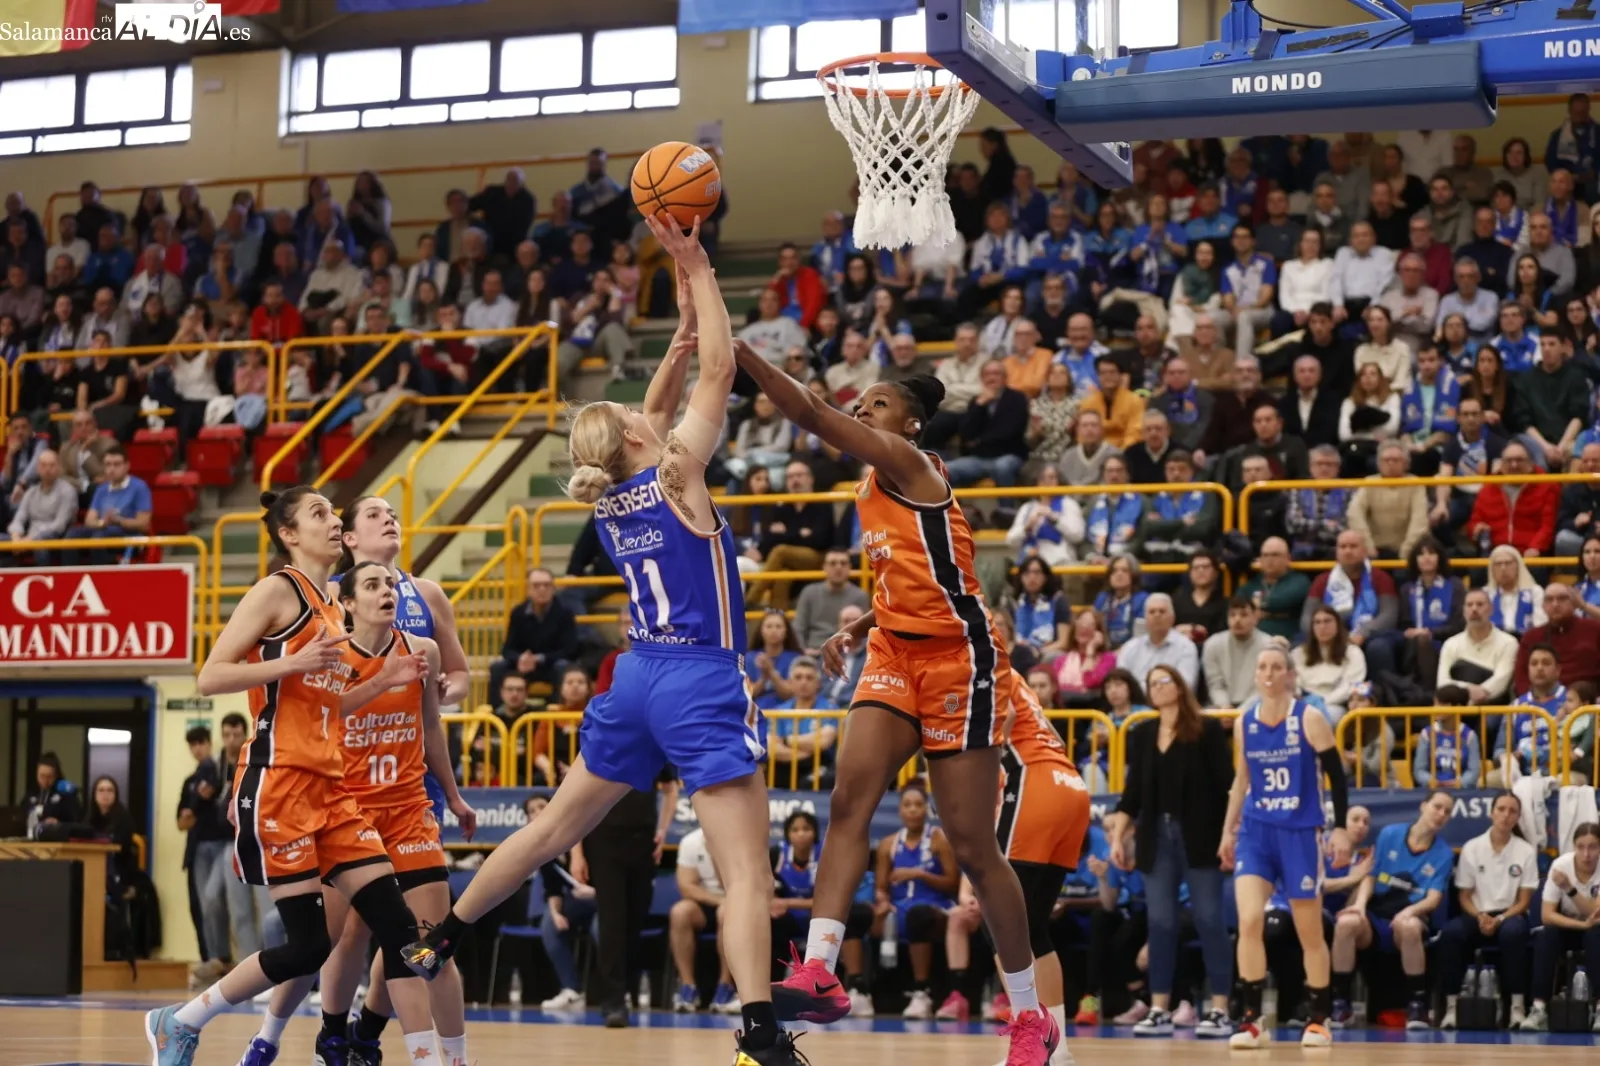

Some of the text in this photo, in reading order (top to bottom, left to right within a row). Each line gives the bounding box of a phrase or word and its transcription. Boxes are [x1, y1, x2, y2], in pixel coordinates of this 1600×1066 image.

[1232, 71, 1322, 94] MONDO
[624, 559, 670, 631] 11
[405, 616, 427, 628] LEÓN
[345, 711, 417, 731] Cultura del
[344, 727, 417, 748] Esfuerzo
[368, 754, 398, 786] 10
[1263, 767, 1290, 792] 30
